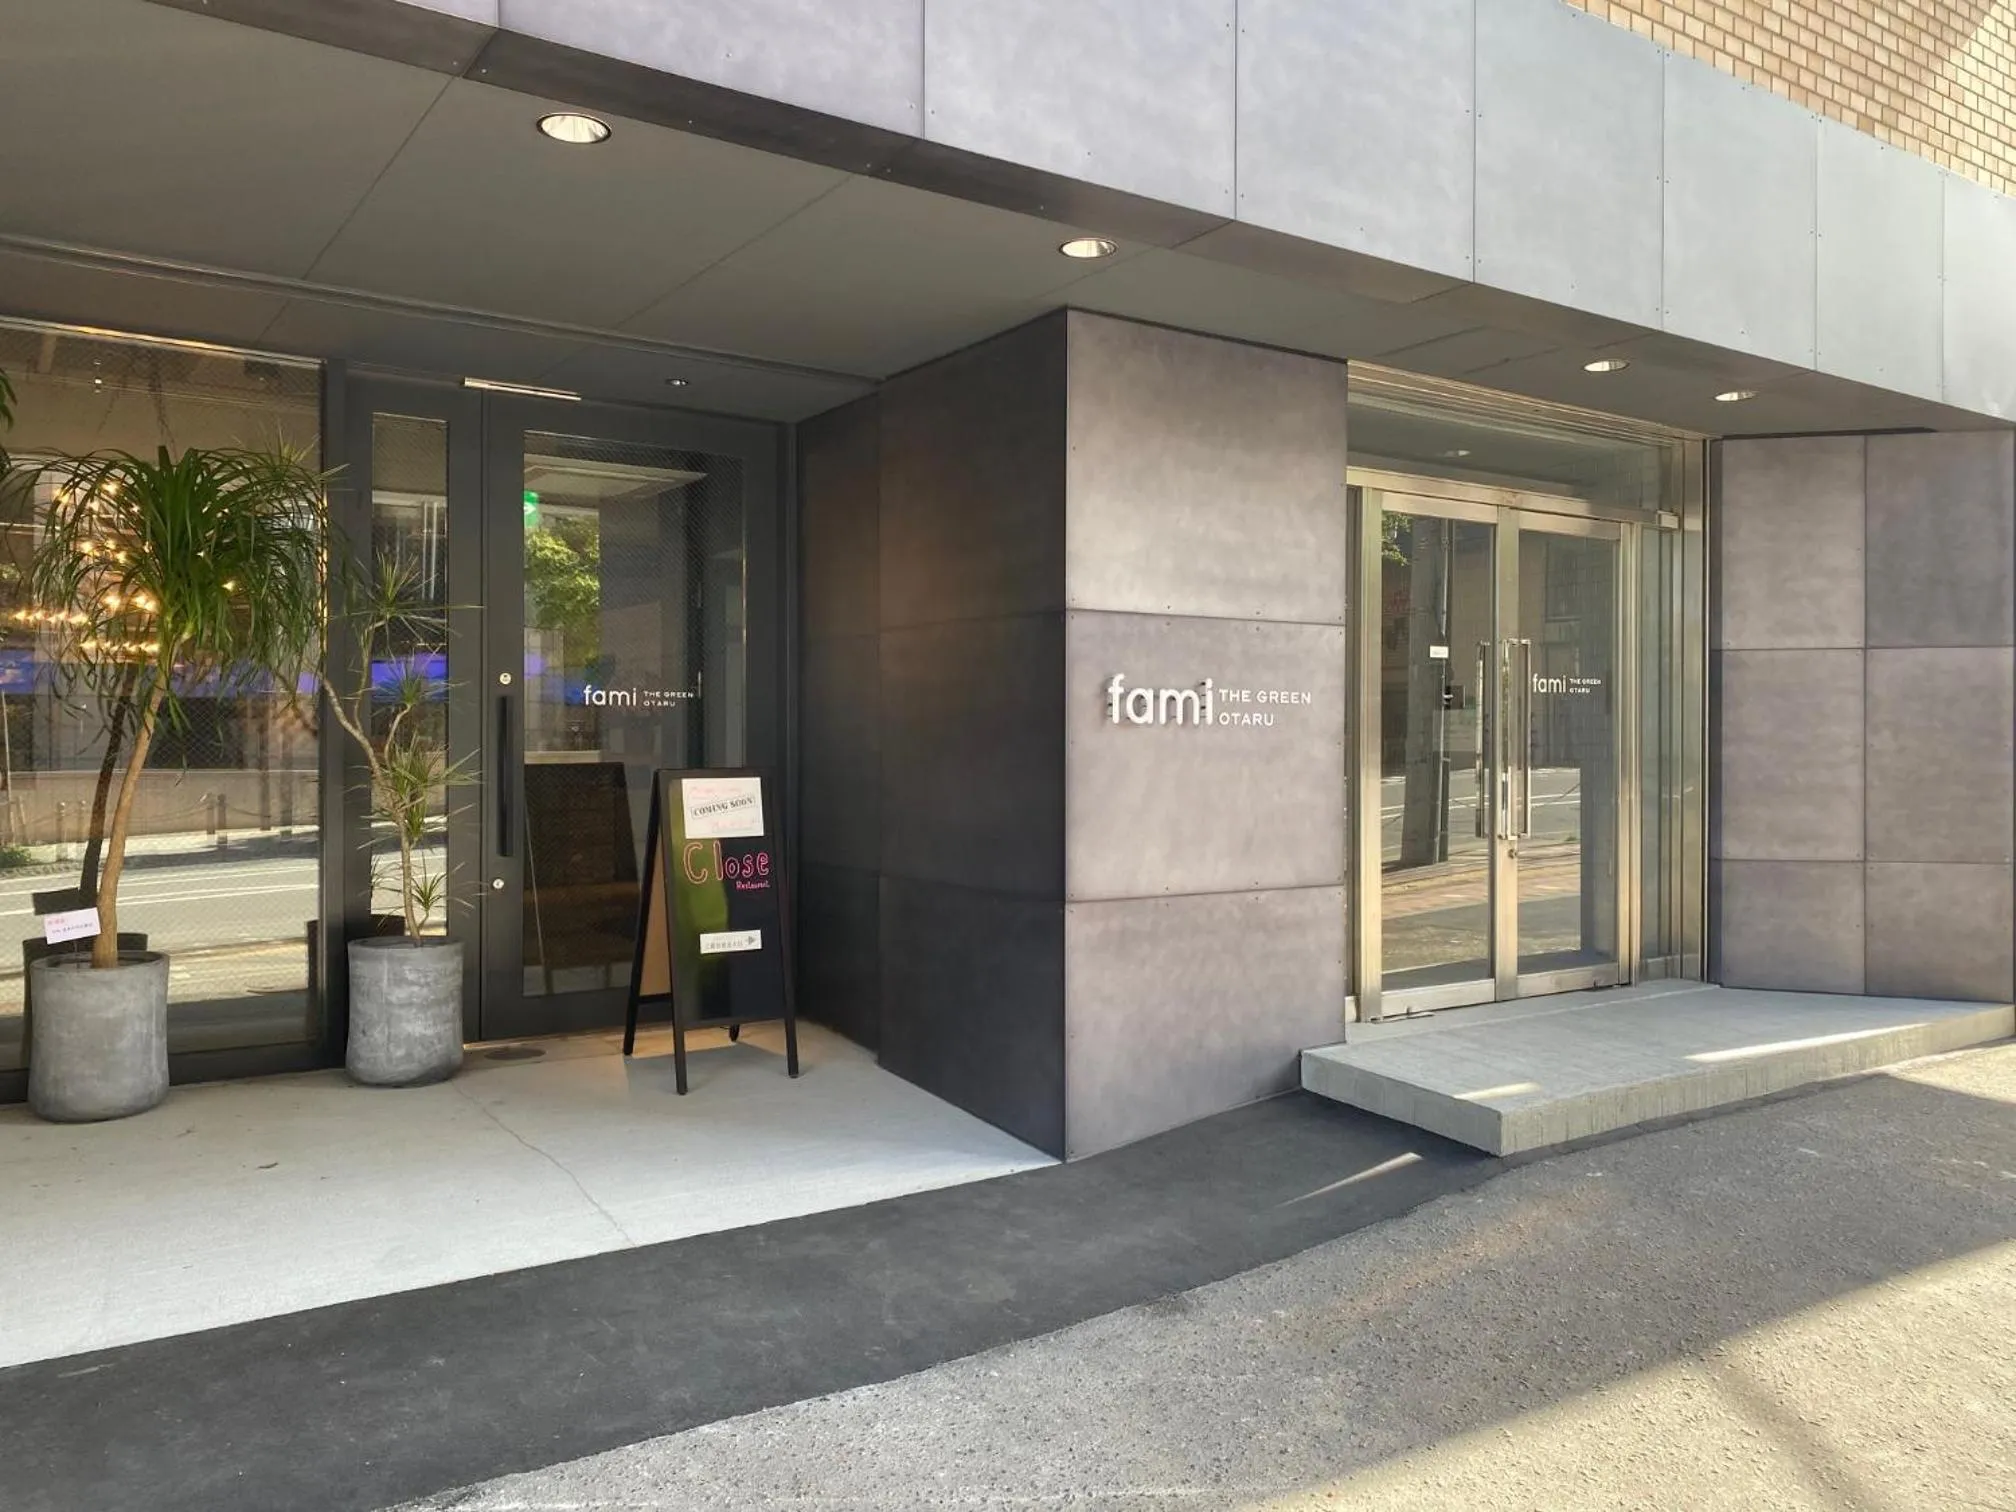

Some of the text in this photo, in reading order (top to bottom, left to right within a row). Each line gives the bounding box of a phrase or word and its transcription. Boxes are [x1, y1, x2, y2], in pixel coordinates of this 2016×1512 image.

[1532, 673, 1567, 693] fami
[583, 684, 637, 706] fami
[663, 691, 694, 699] GREEN
[1107, 673, 1214, 725] fami
[1219, 688, 1312, 705] THE GREEN
[1219, 712, 1275, 727] OTARU
[694, 796, 753, 816] COMING SOON
[683, 840, 770, 885] Close
